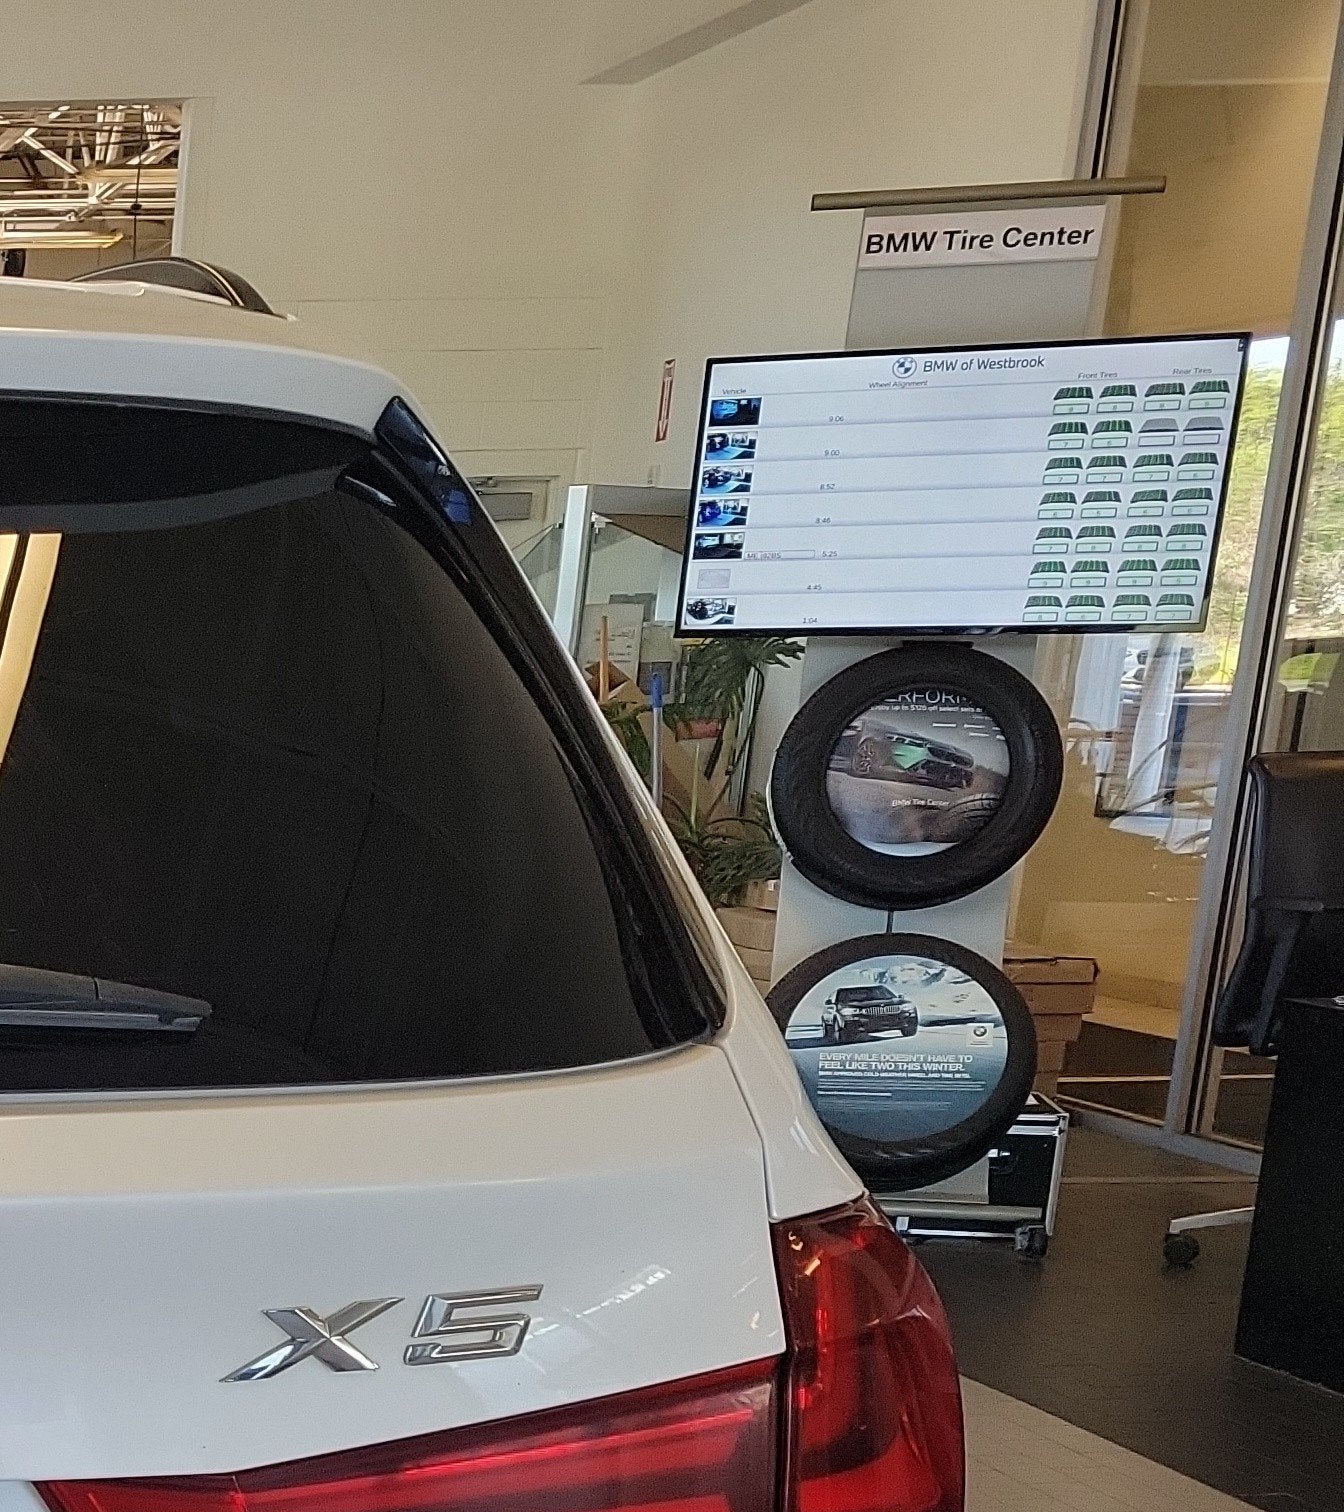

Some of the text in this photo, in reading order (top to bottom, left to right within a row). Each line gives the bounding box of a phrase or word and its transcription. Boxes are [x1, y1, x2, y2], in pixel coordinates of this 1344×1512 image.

[865, 226, 1095, 254] BMW Tire Center
[923, 359, 958, 372] BMW
[961, 358, 974, 371] of
[977, 355, 1045, 371] Westbrook
[869, 379, 928, 389] Wheel Alignment
[819, 1052, 973, 1063] EVERY MILE DOESN'T HAVE TO
[819, 1061, 965, 1071] FEEL LIKE TWO THIS WINTER.
[218, 1284, 544, 1383] X5
